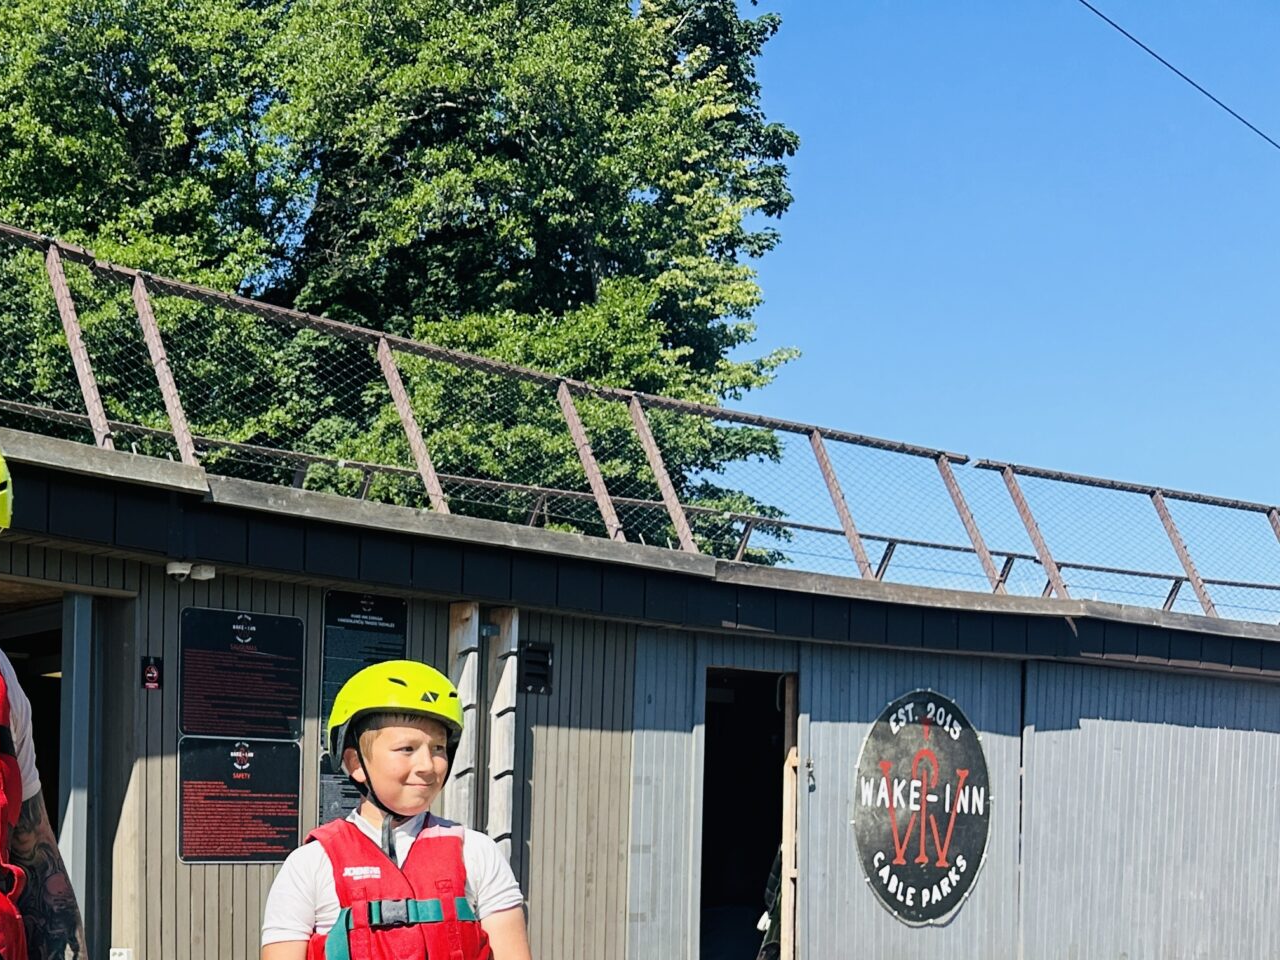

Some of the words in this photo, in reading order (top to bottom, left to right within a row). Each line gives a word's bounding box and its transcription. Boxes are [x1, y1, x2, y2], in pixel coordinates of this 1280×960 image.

[889, 702, 918, 735] EST.
[861, 776, 985, 815] WAKE-INN
[873, 851, 917, 906] CABLE
[922, 855, 968, 907] PARKS
